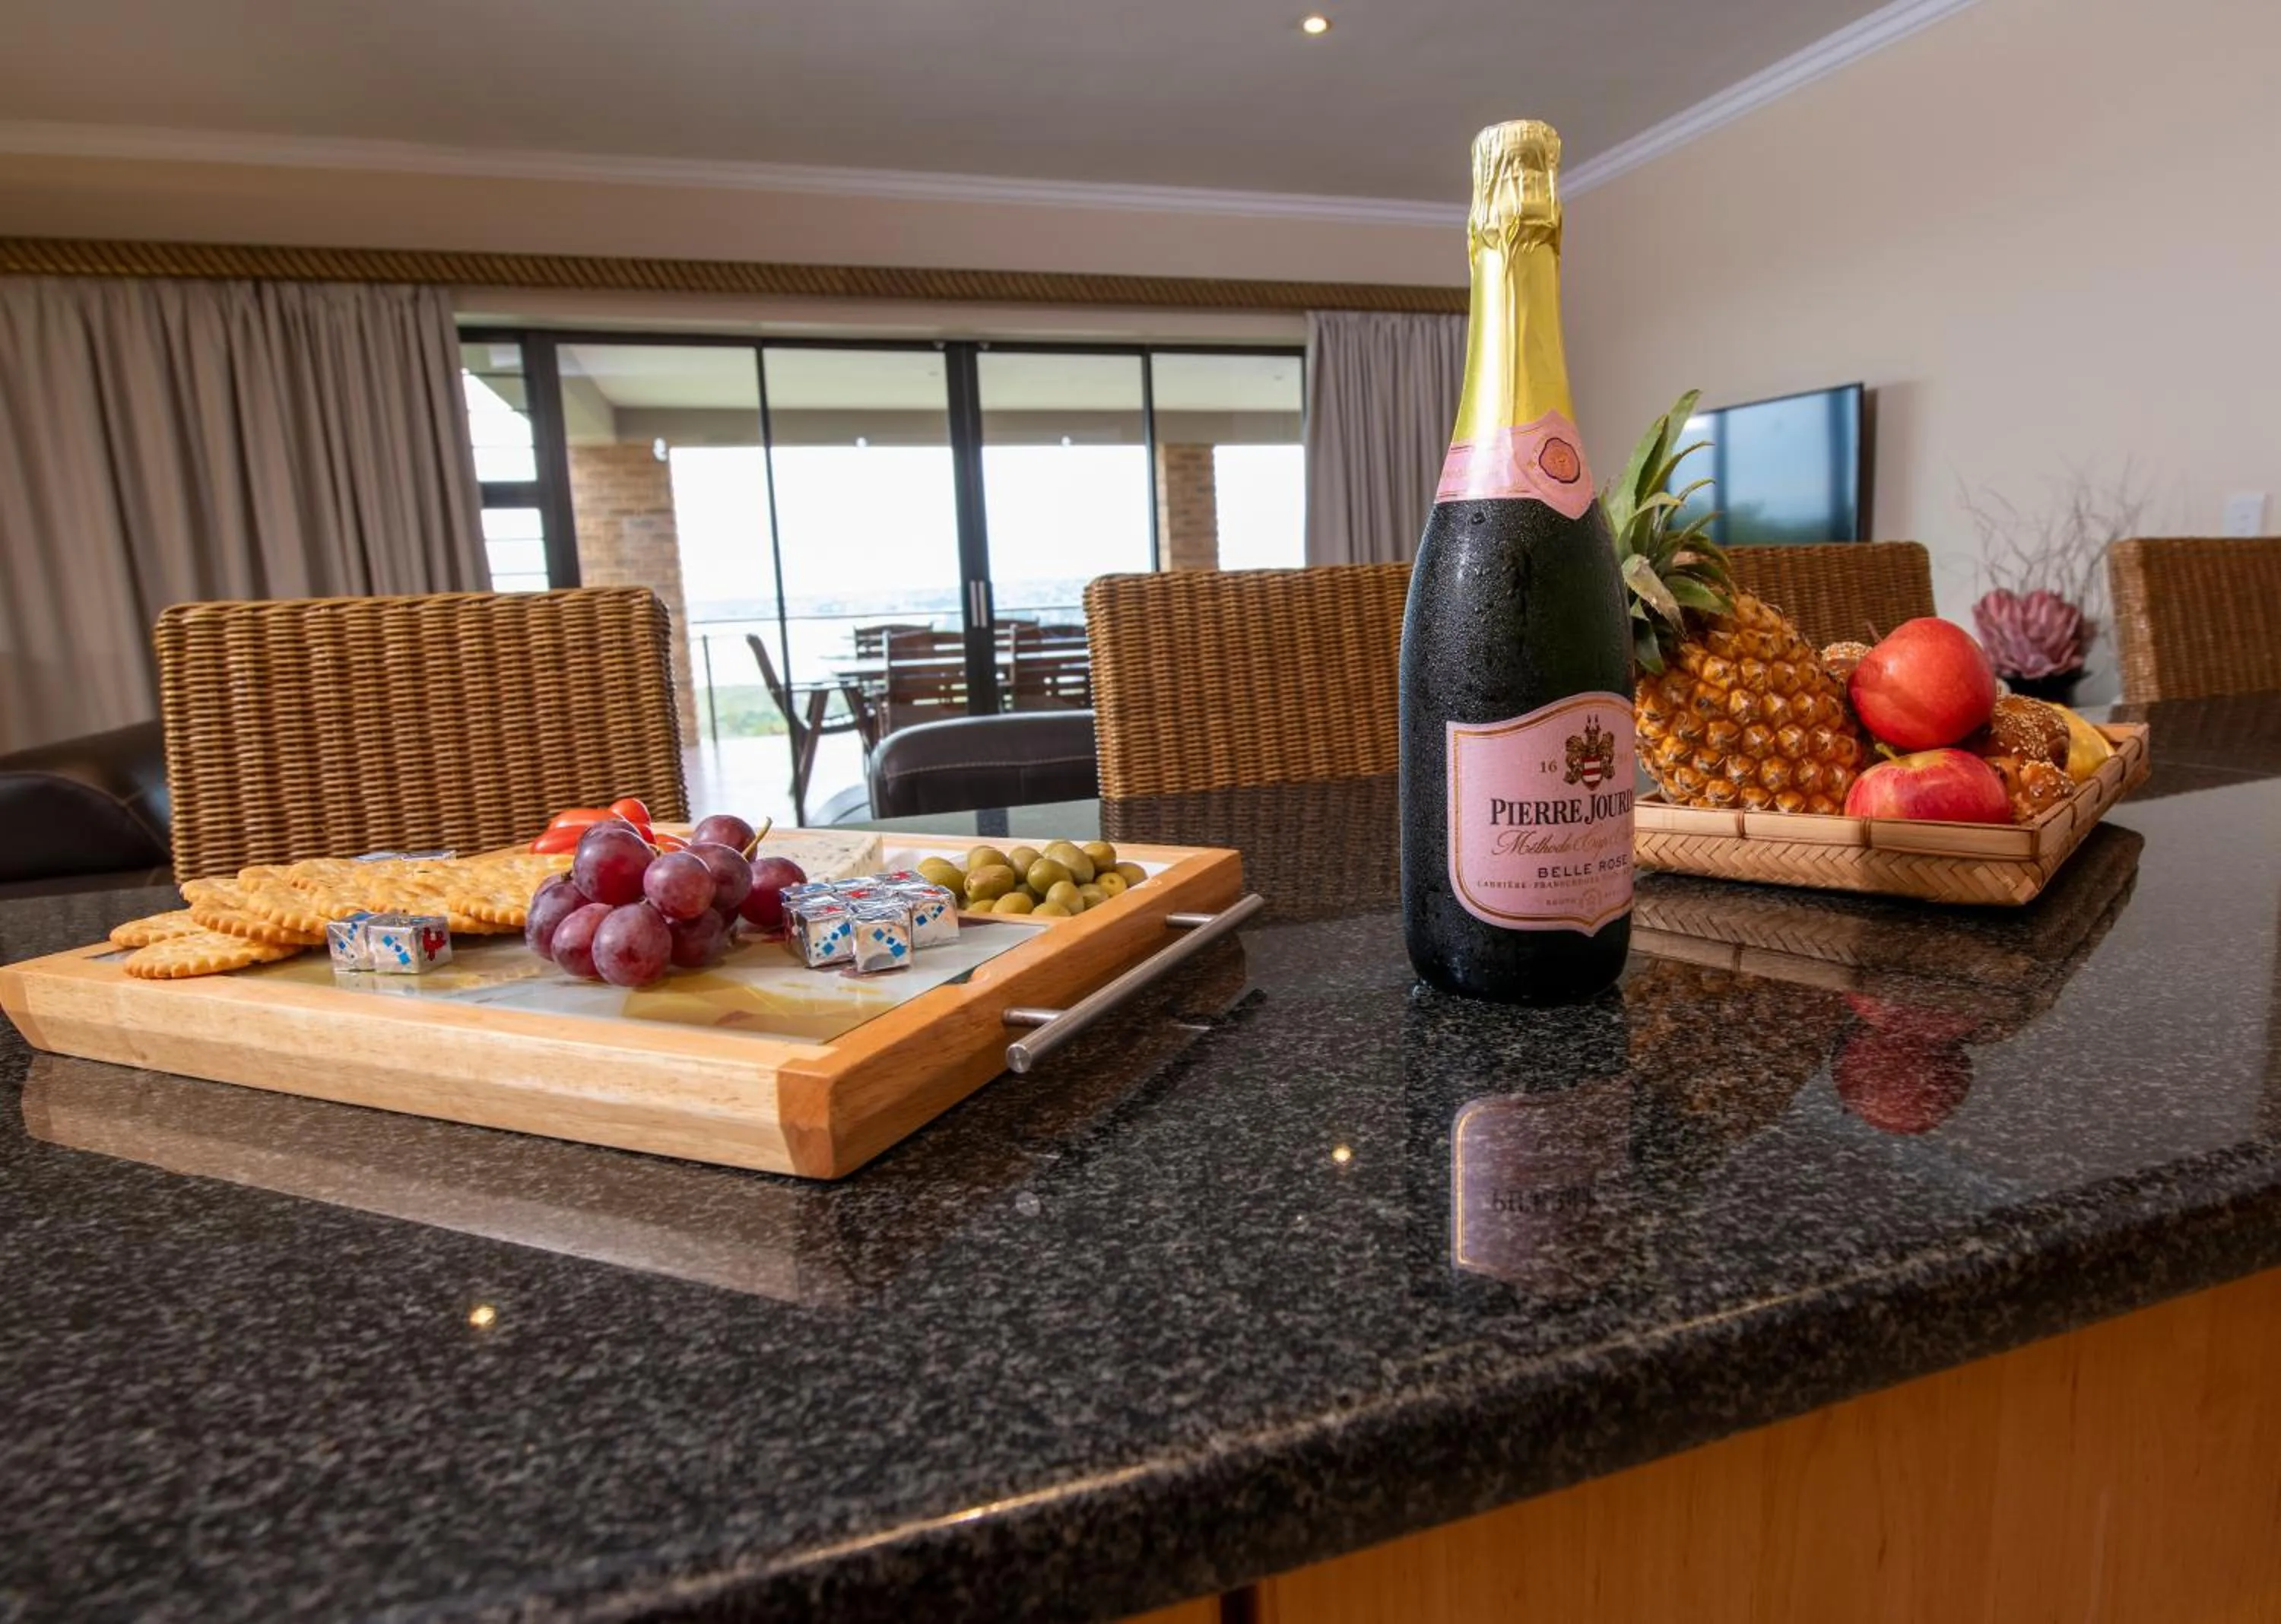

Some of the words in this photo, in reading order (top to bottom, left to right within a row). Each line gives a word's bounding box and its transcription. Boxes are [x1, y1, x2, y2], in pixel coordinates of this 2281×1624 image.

[1539, 760, 1558, 773] 16
[1490, 798, 1582, 826] PIERRE
[1538, 863, 1591, 878] BELLE
[1598, 854, 1628, 872] ROSE
